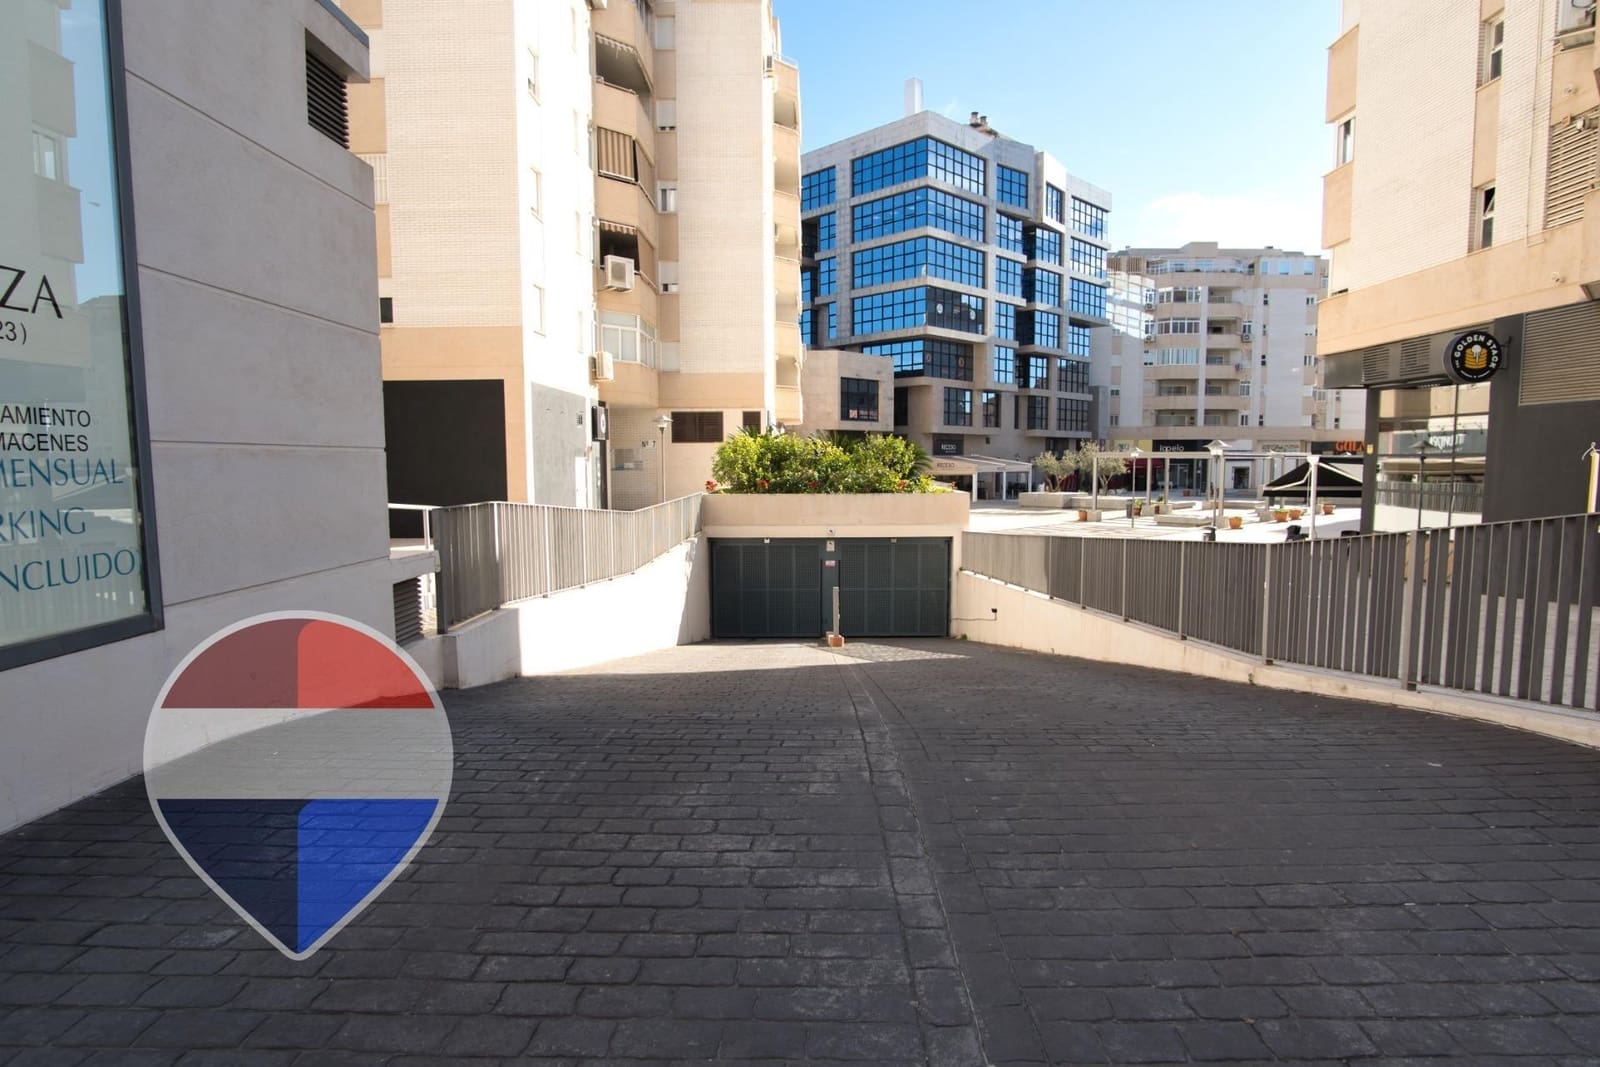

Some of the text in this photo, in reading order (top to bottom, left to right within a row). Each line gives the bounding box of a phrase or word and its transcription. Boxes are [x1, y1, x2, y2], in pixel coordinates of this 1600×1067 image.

[0, 265, 63, 319] ZA
[1454, 334, 1499, 369] GOLDEN STACK
[0, 405, 91, 428] AMIENTO
